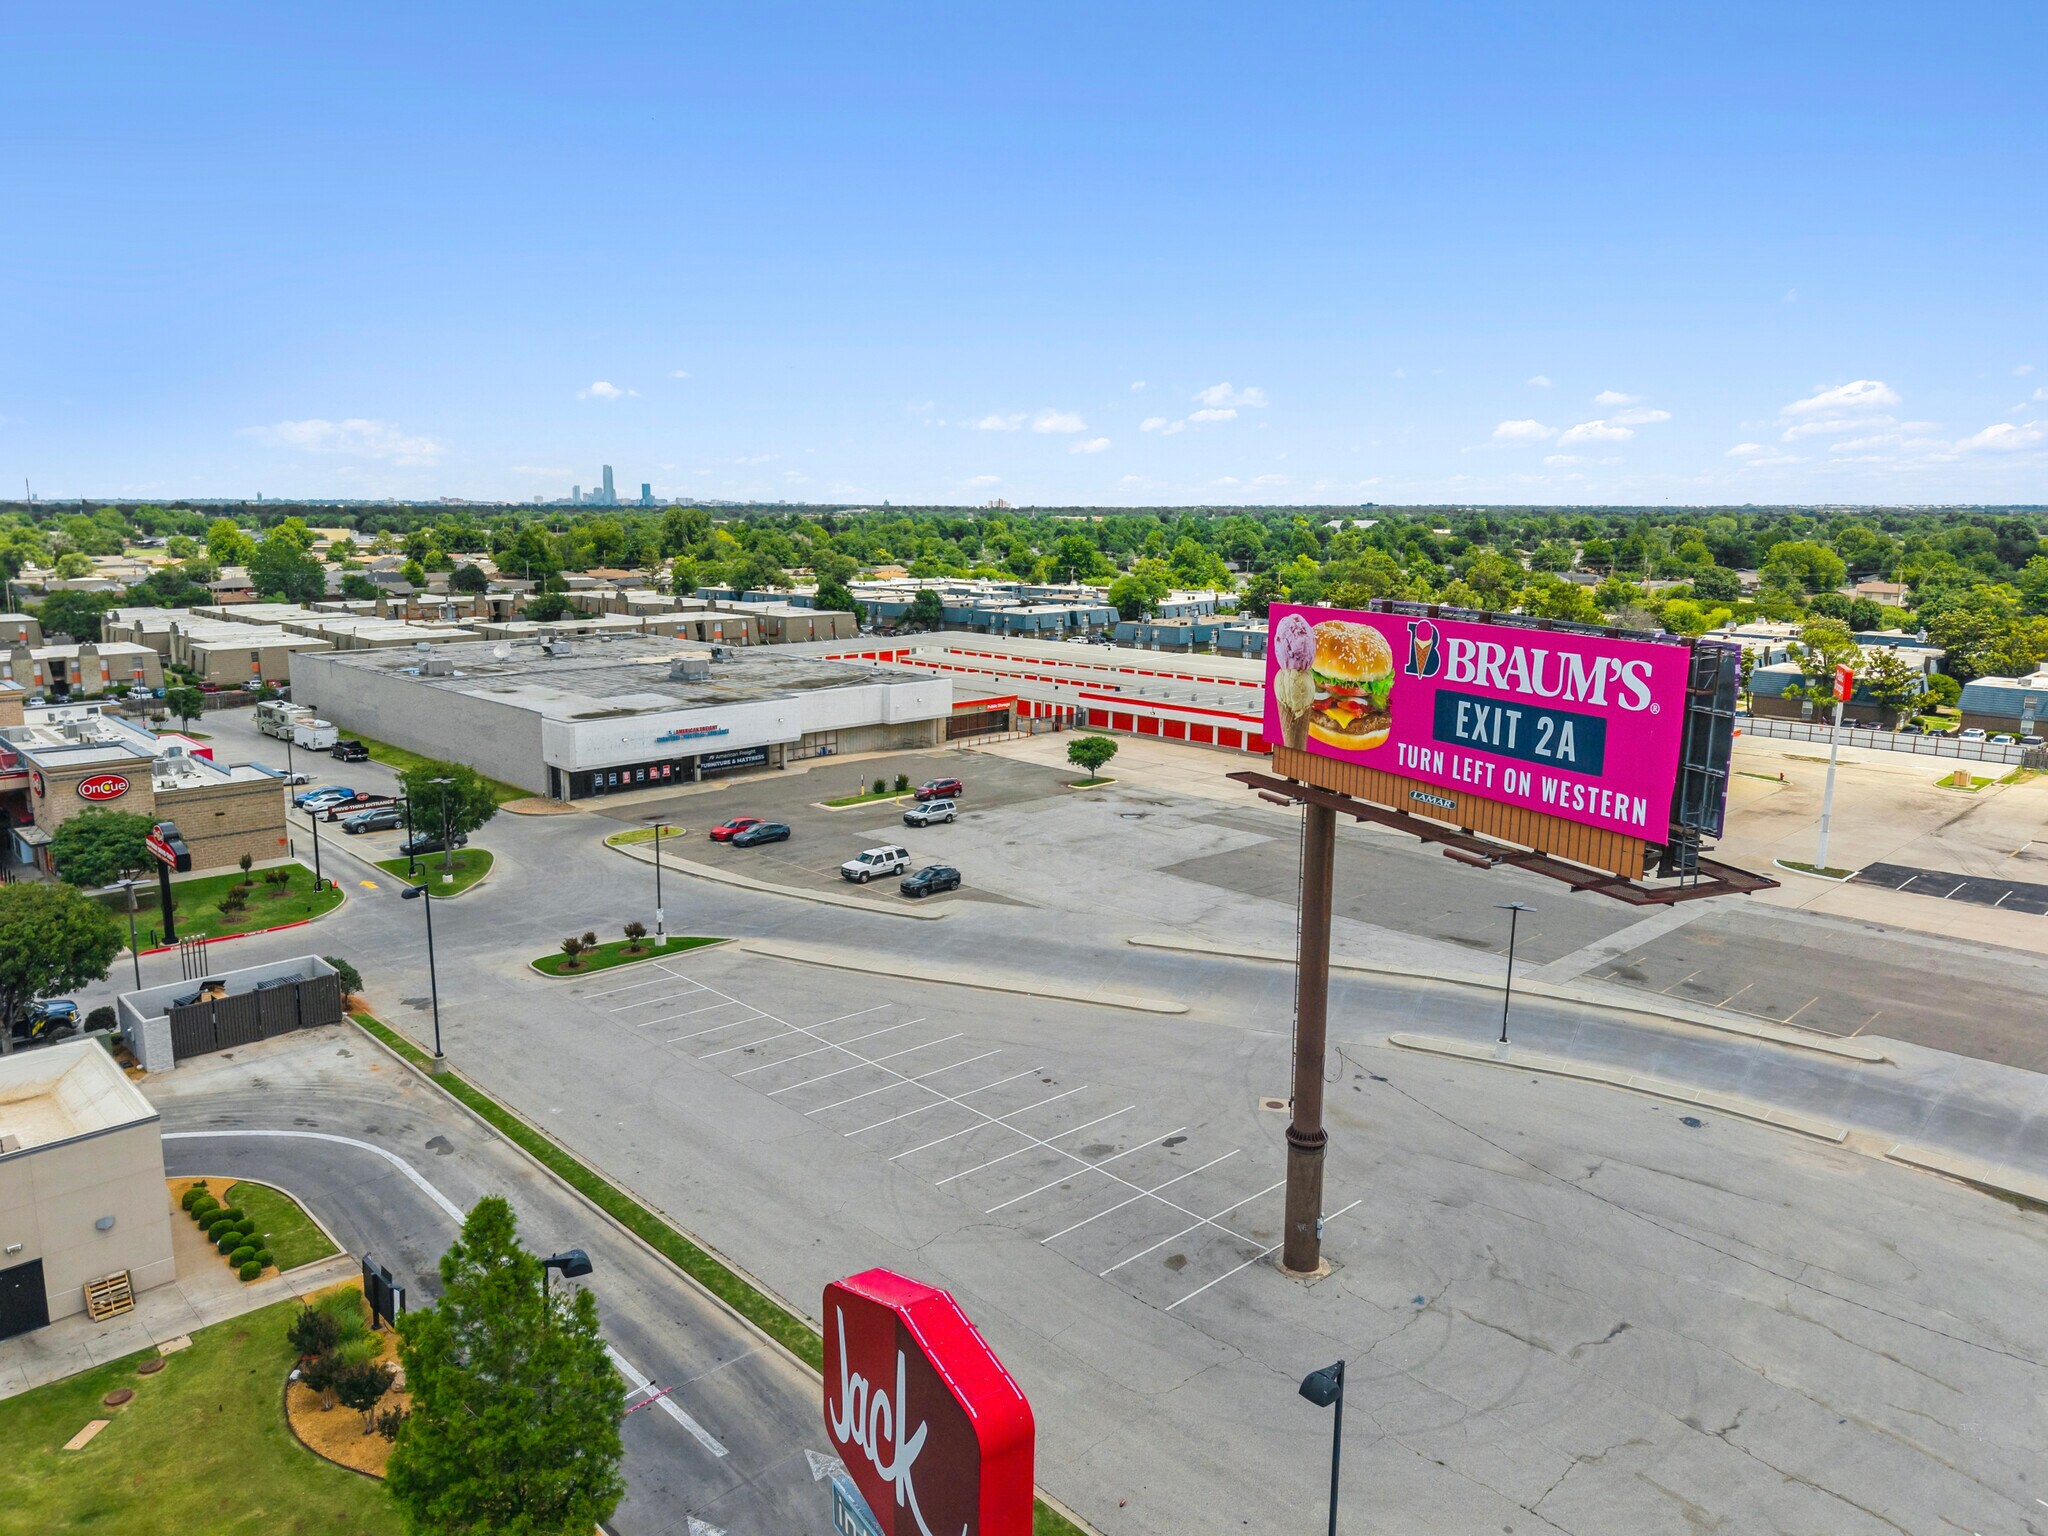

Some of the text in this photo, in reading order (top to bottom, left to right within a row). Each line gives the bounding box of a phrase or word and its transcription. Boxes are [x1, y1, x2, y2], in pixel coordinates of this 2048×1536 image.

[1443, 637, 1653, 712] BRAUM'S
[1455, 700, 1576, 762] EXIT 2A
[700, 759, 731, 768] FURNITURE
[736, 754, 765, 763] MATTRESS
[715, 749, 756, 759] American Freight
[81, 780, 126, 795] OnCue
[1397, 742, 1647, 827] TURN LEFT ON WESTERN
[1413, 792, 1451, 808] LAMAR
[829, 1304, 935, 1536] Jack
